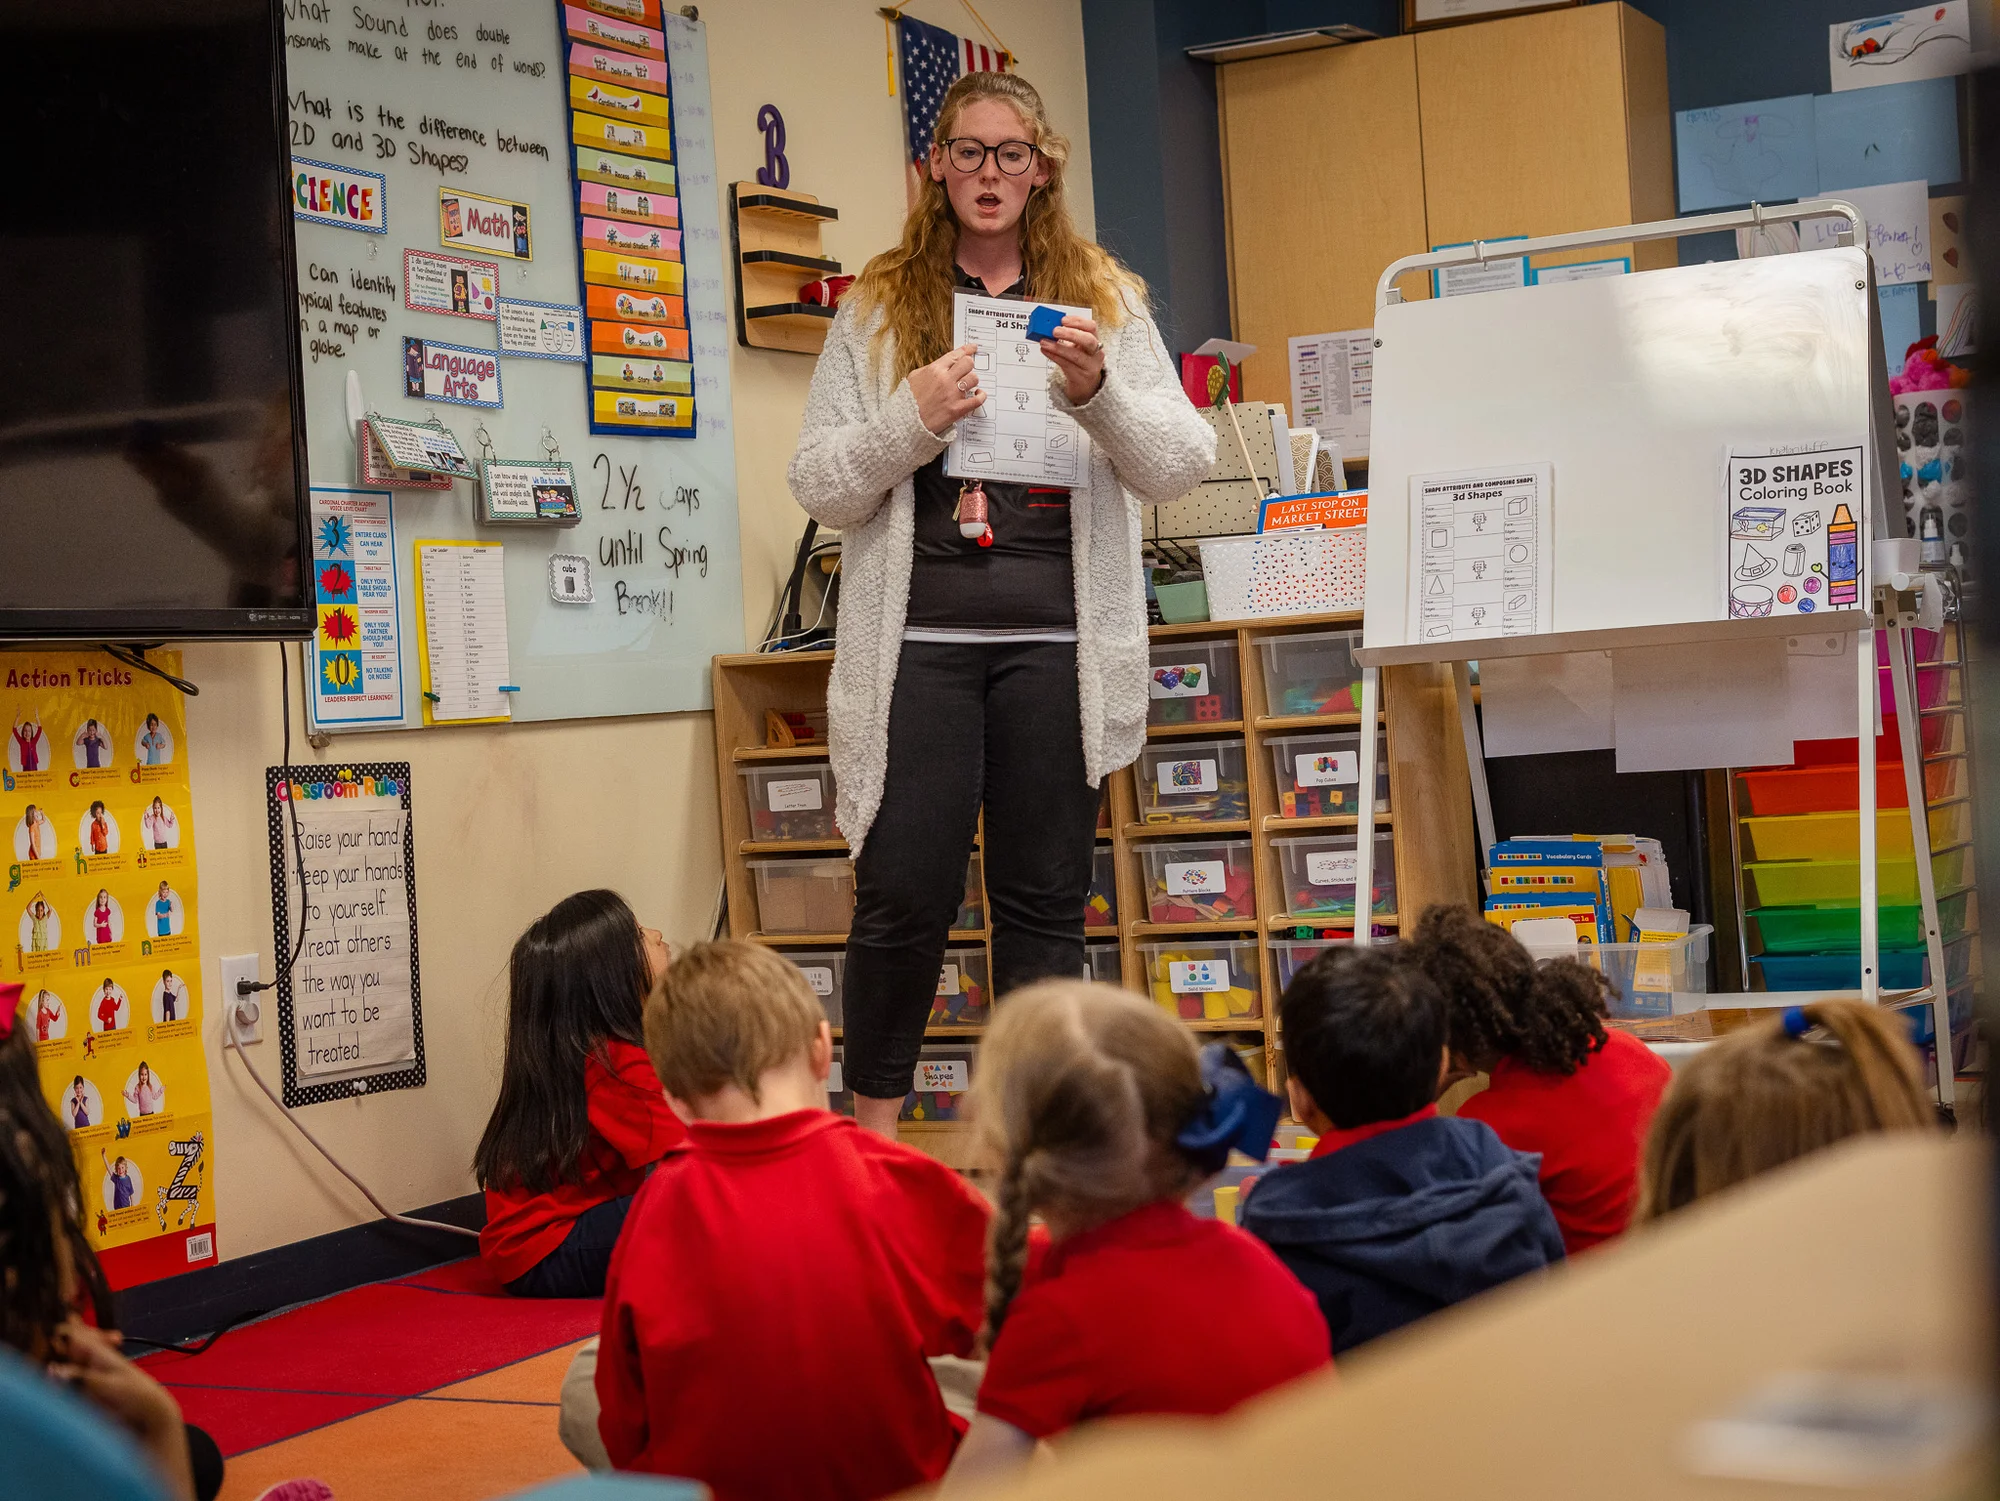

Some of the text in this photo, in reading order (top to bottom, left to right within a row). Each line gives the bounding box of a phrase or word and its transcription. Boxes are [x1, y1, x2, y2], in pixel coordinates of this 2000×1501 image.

[353, 6, 408, 38] Sound
[427, 20, 459, 41] does
[476, 23, 510, 45] double
[285, 33, 546, 79] nsonats make at the end of words?
[611, 66, 633, 77] Daily Five
[598, 98, 628, 110] Cardinal Time
[348, 101, 364, 123] is
[378, 105, 405, 130] the
[420, 115, 486, 147] difference
[497, 129, 549, 162] between
[618, 139, 632, 147] Lunch
[289, 120, 468, 176] 2D and 3D Shapes?
[757, 104, 790, 190] B
[614, 171, 630, 180] Recess
[292, 170, 373, 220] CIENCE
[467, 208, 511, 239] Math
[620, 207, 637, 216] Science
[618, 240, 649, 250] Social Studies
[309, 263, 338, 283] Can
[350, 268, 395, 301] identify
[633, 275, 640, 283] PE
[338, 293, 387, 322] features
[638, 310, 649, 318] Math
[968, 308, 984, 316] SHAPE
[985, 309, 1015, 319] ATTRIBUTE
[334, 321, 358, 344] map
[368, 326, 380, 338] or
[995, 320, 1028, 331] 3d Sha
[310, 338, 345, 363] globe.
[639, 339, 652, 347] Snack
[423, 346, 495, 381] Language
[443, 374, 478, 399] Arts
[637, 376, 650, 385] Story
[637, 409, 658, 418] Dismissal
[532, 476, 540, 484] We
[1739, 459, 1853, 485] 3D SHAPES
[1442, 483, 1471, 492] ATTRIBUTE
[1485, 479, 1516, 487] COMPOSING
[1452, 490, 1503, 501] 3d Shapes
[1739, 479, 1853, 500] Coloring Book
[1271, 507, 1368, 526] MARKET STREET
[1281, 498, 1359, 514] LAST STOP ON
[328, 516, 340, 547] 3
[599, 526, 708, 578] until Spring
[330, 563, 343, 594] 2
[562, 564, 577, 574] cube
[334, 607, 346, 639] 1
[6, 667, 132, 688] Action Tricks
[335, 653, 350, 685] 0
[3, 767, 16, 792] b
[130, 761, 141, 784] d
[275, 775, 406, 802] Classroom Rules
[295, 818, 401, 855] Raise your hand.
[75, 851, 88, 875] h
[333, 868, 360, 890] your
[364, 852, 403, 881] hands
[306, 888, 388, 927] to yourself.
[74, 941, 91, 967] m
[141, 940, 153, 956] n
[303, 925, 391, 958] Treat others
[302, 964, 380, 996] the way you
[302, 996, 380, 1030] want to be
[308, 1031, 365, 1065] treated.
[923, 1070, 954, 1082] Shapes
